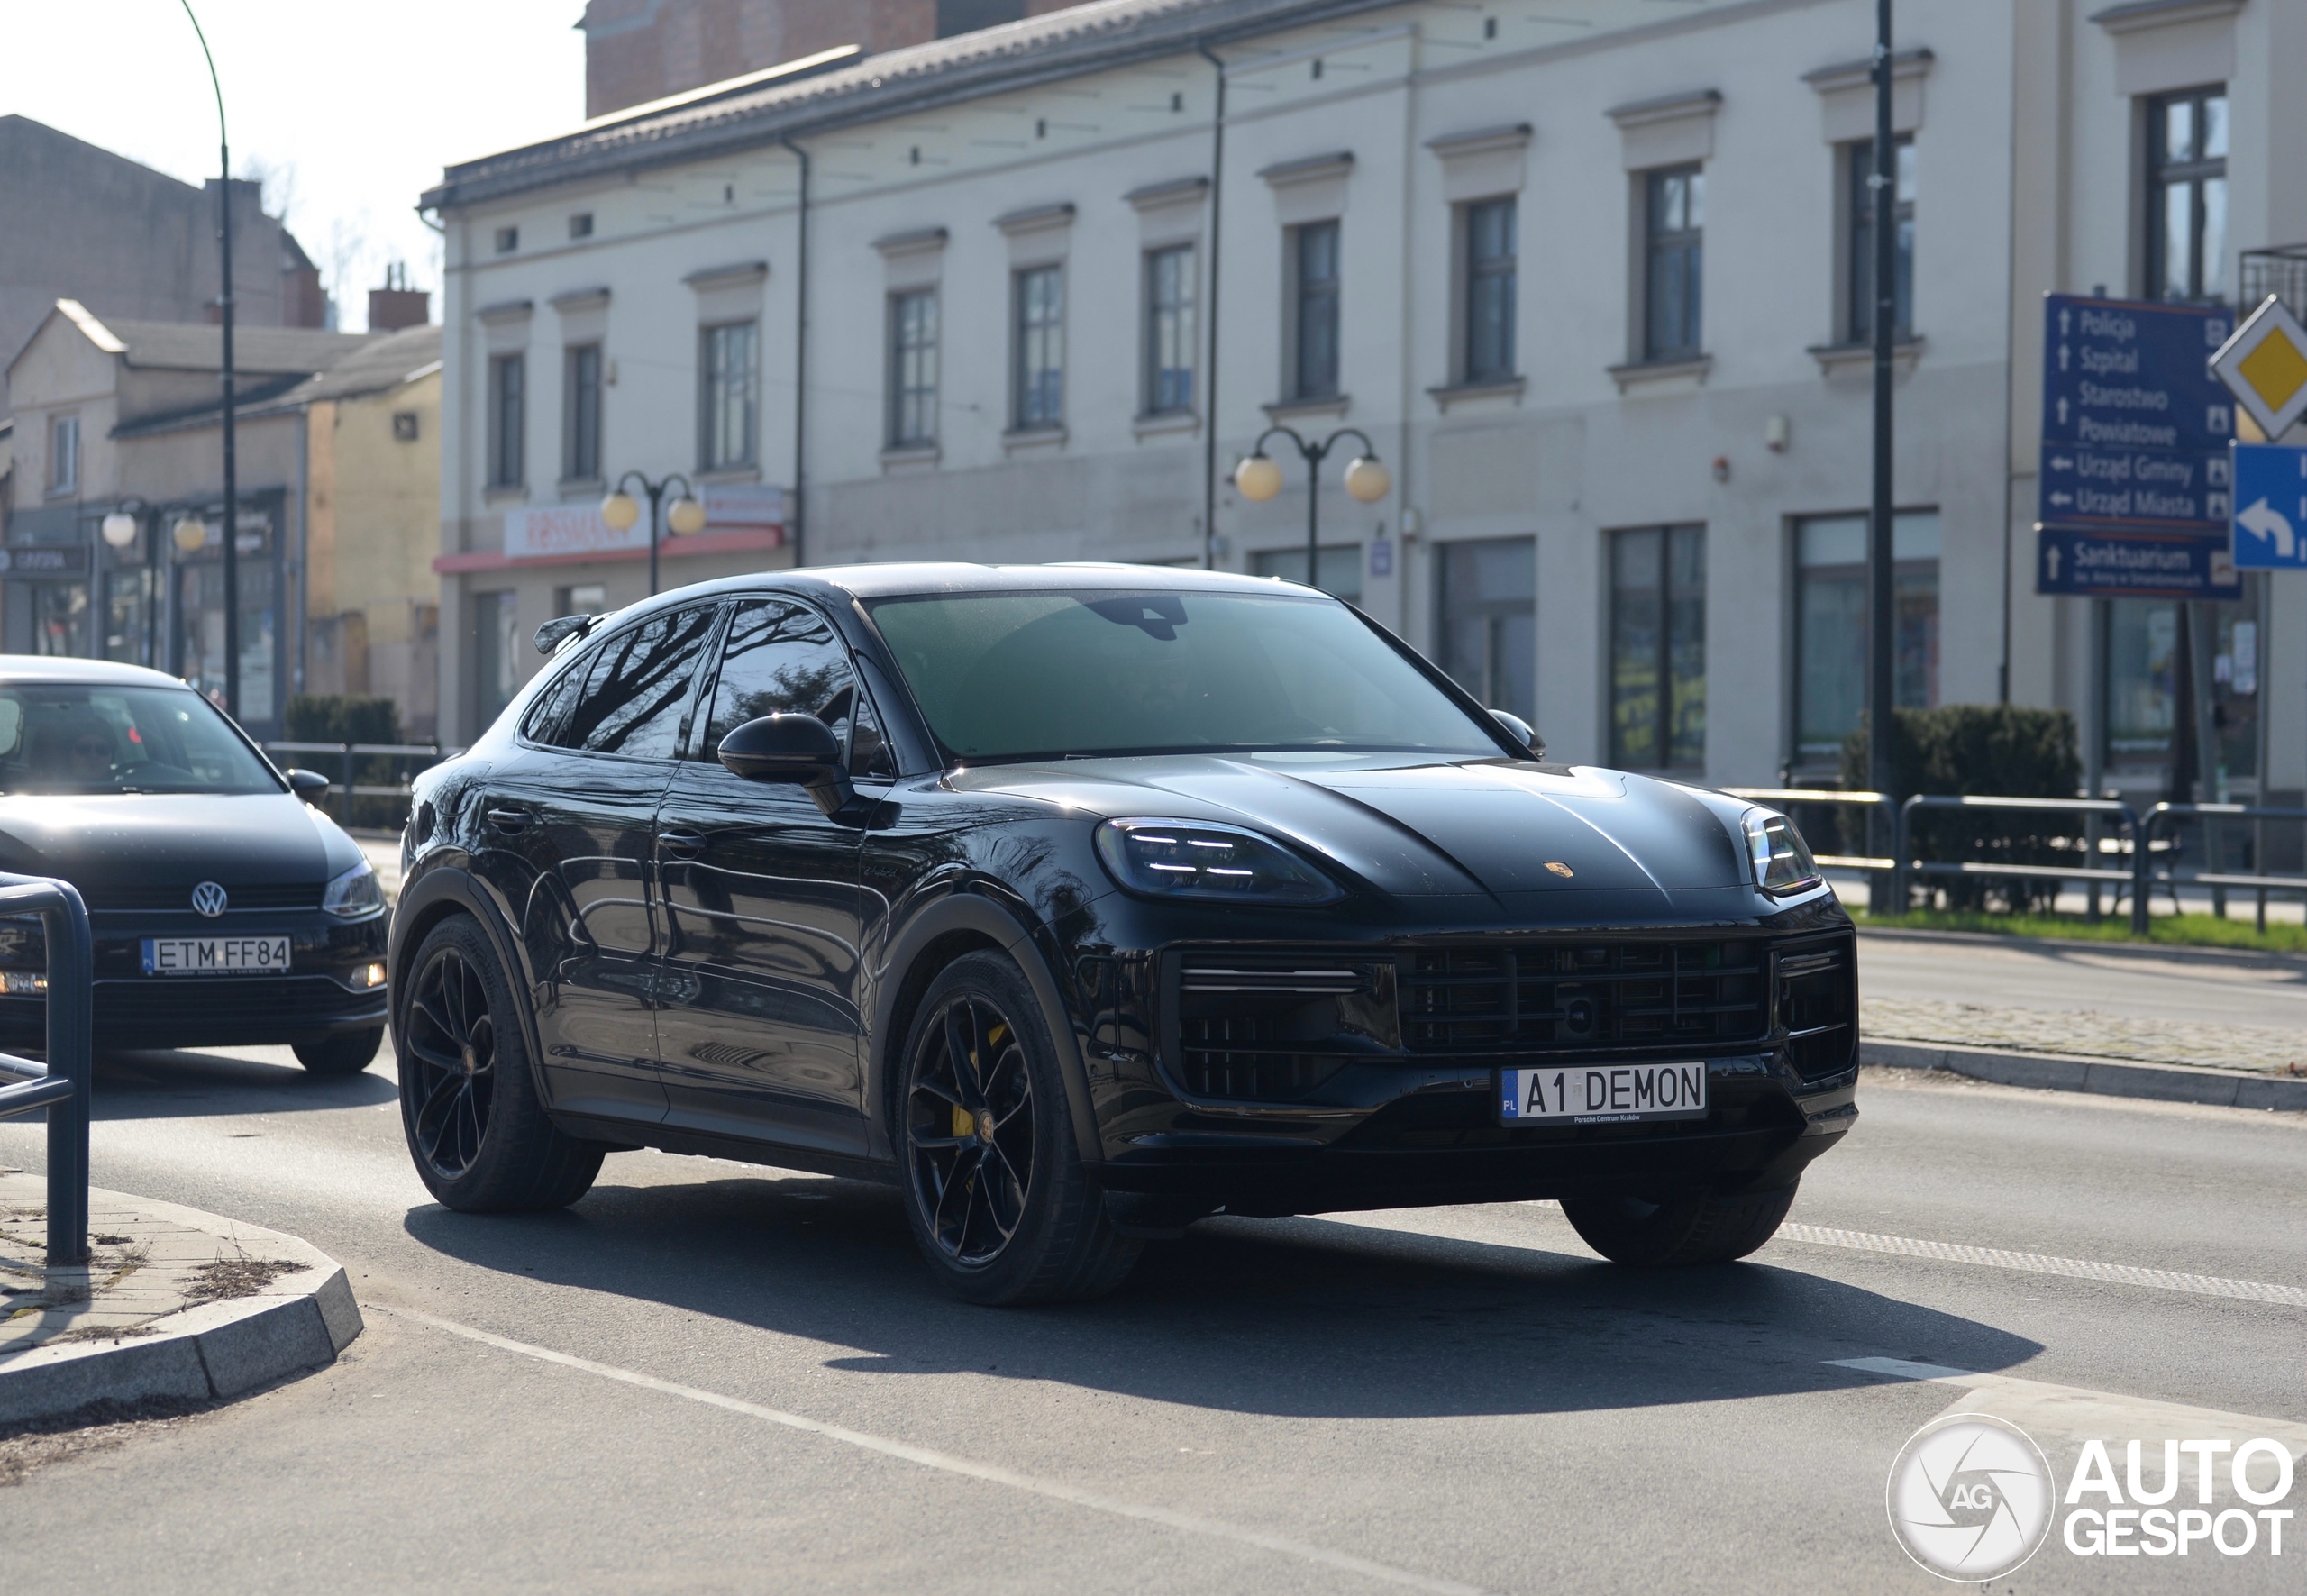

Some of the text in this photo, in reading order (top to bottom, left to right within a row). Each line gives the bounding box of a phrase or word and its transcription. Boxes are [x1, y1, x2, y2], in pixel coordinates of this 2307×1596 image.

[2080, 312, 2136, 341] Policja
[2080, 345, 2138, 376] Szpital
[2079, 381, 2168, 411] Starostwo
[2078, 416, 2177, 446] Powiatowe
[2135, 456, 2193, 488] Gminy
[2135, 492, 2196, 518] Miasta
[2075, 543, 2191, 570] Sanktuarium
[159, 940, 286, 968] ETM FF84
[1526, 1067, 1701, 1113] A1 DEMON
[1503, 1100, 1516, 1111] PL
[1574, 1113, 1640, 1124] Porsche Centrum Kraków
